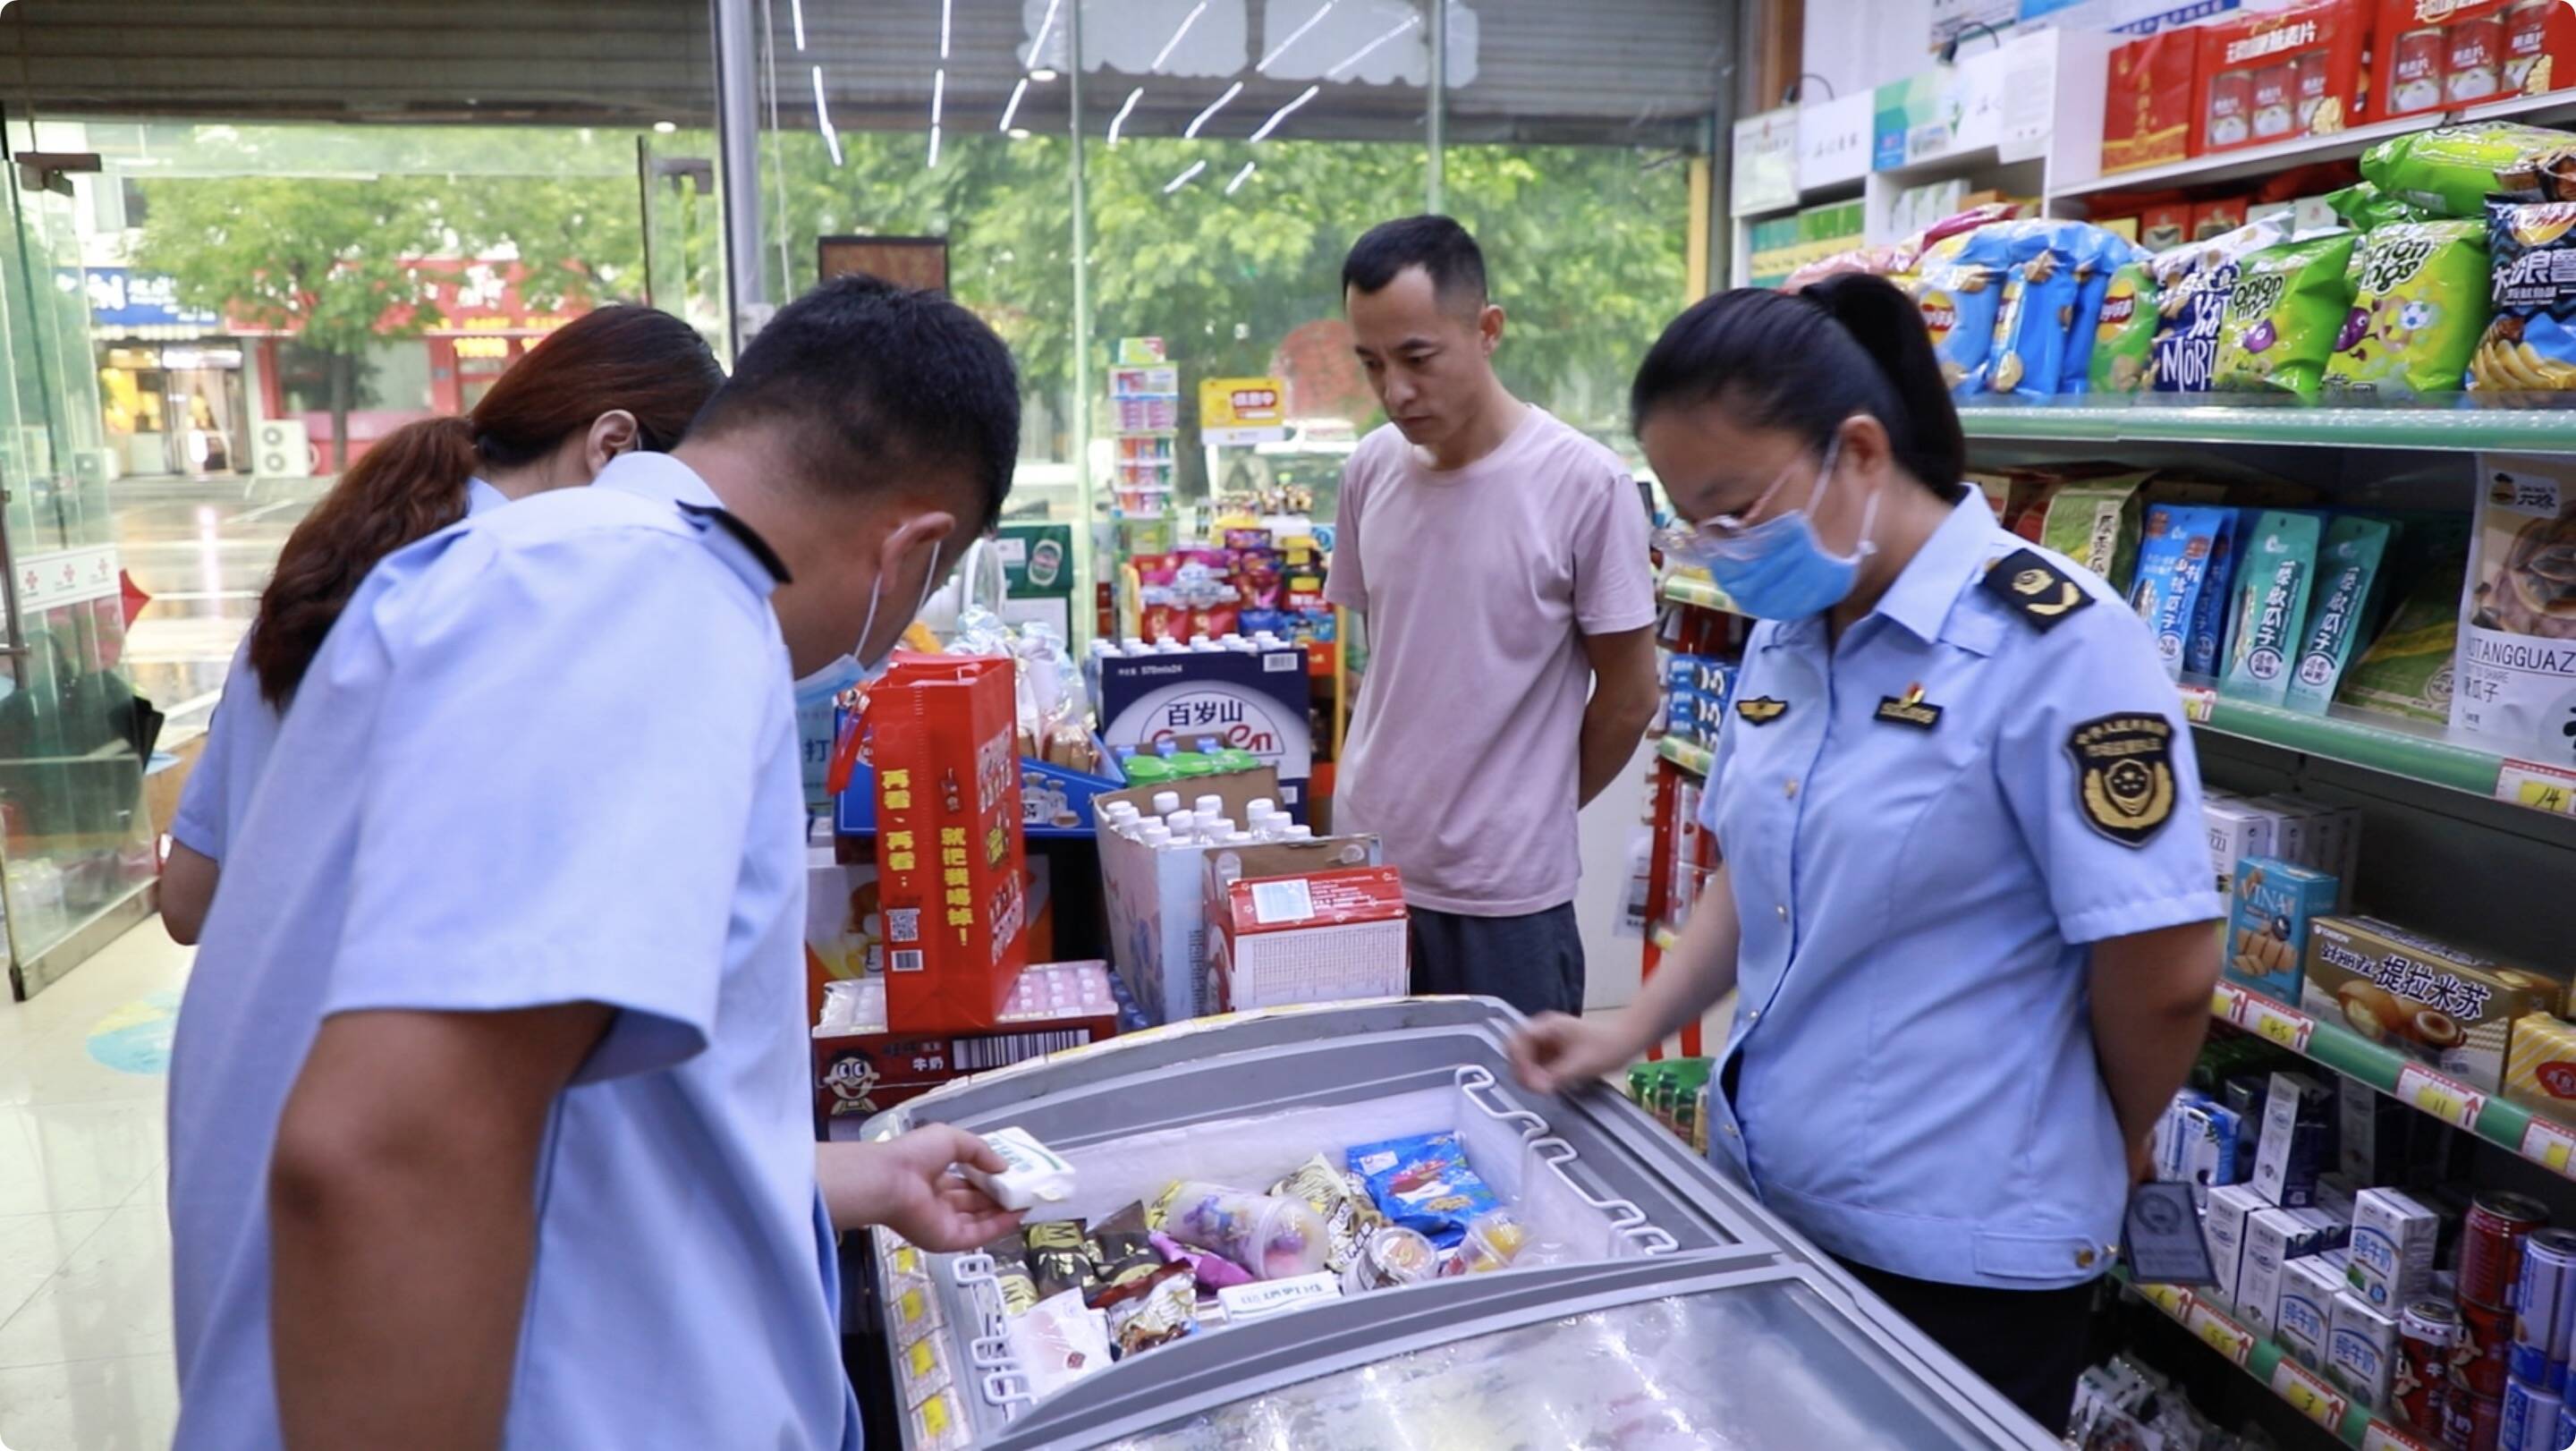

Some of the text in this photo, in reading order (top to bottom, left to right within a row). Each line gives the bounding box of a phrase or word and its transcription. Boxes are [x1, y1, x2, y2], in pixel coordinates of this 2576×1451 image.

[1168, 700, 1243, 726] 百岁山
[2376, 952, 2493, 1021] 提拉米苏
[2353, 1231, 2393, 1274] 纯牛奶
[2284, 1300, 2320, 1340] 纯牛奶
[2334, 1334, 2376, 1375] 纯牛奶
[2304, 1393, 2316, 1412] 3
